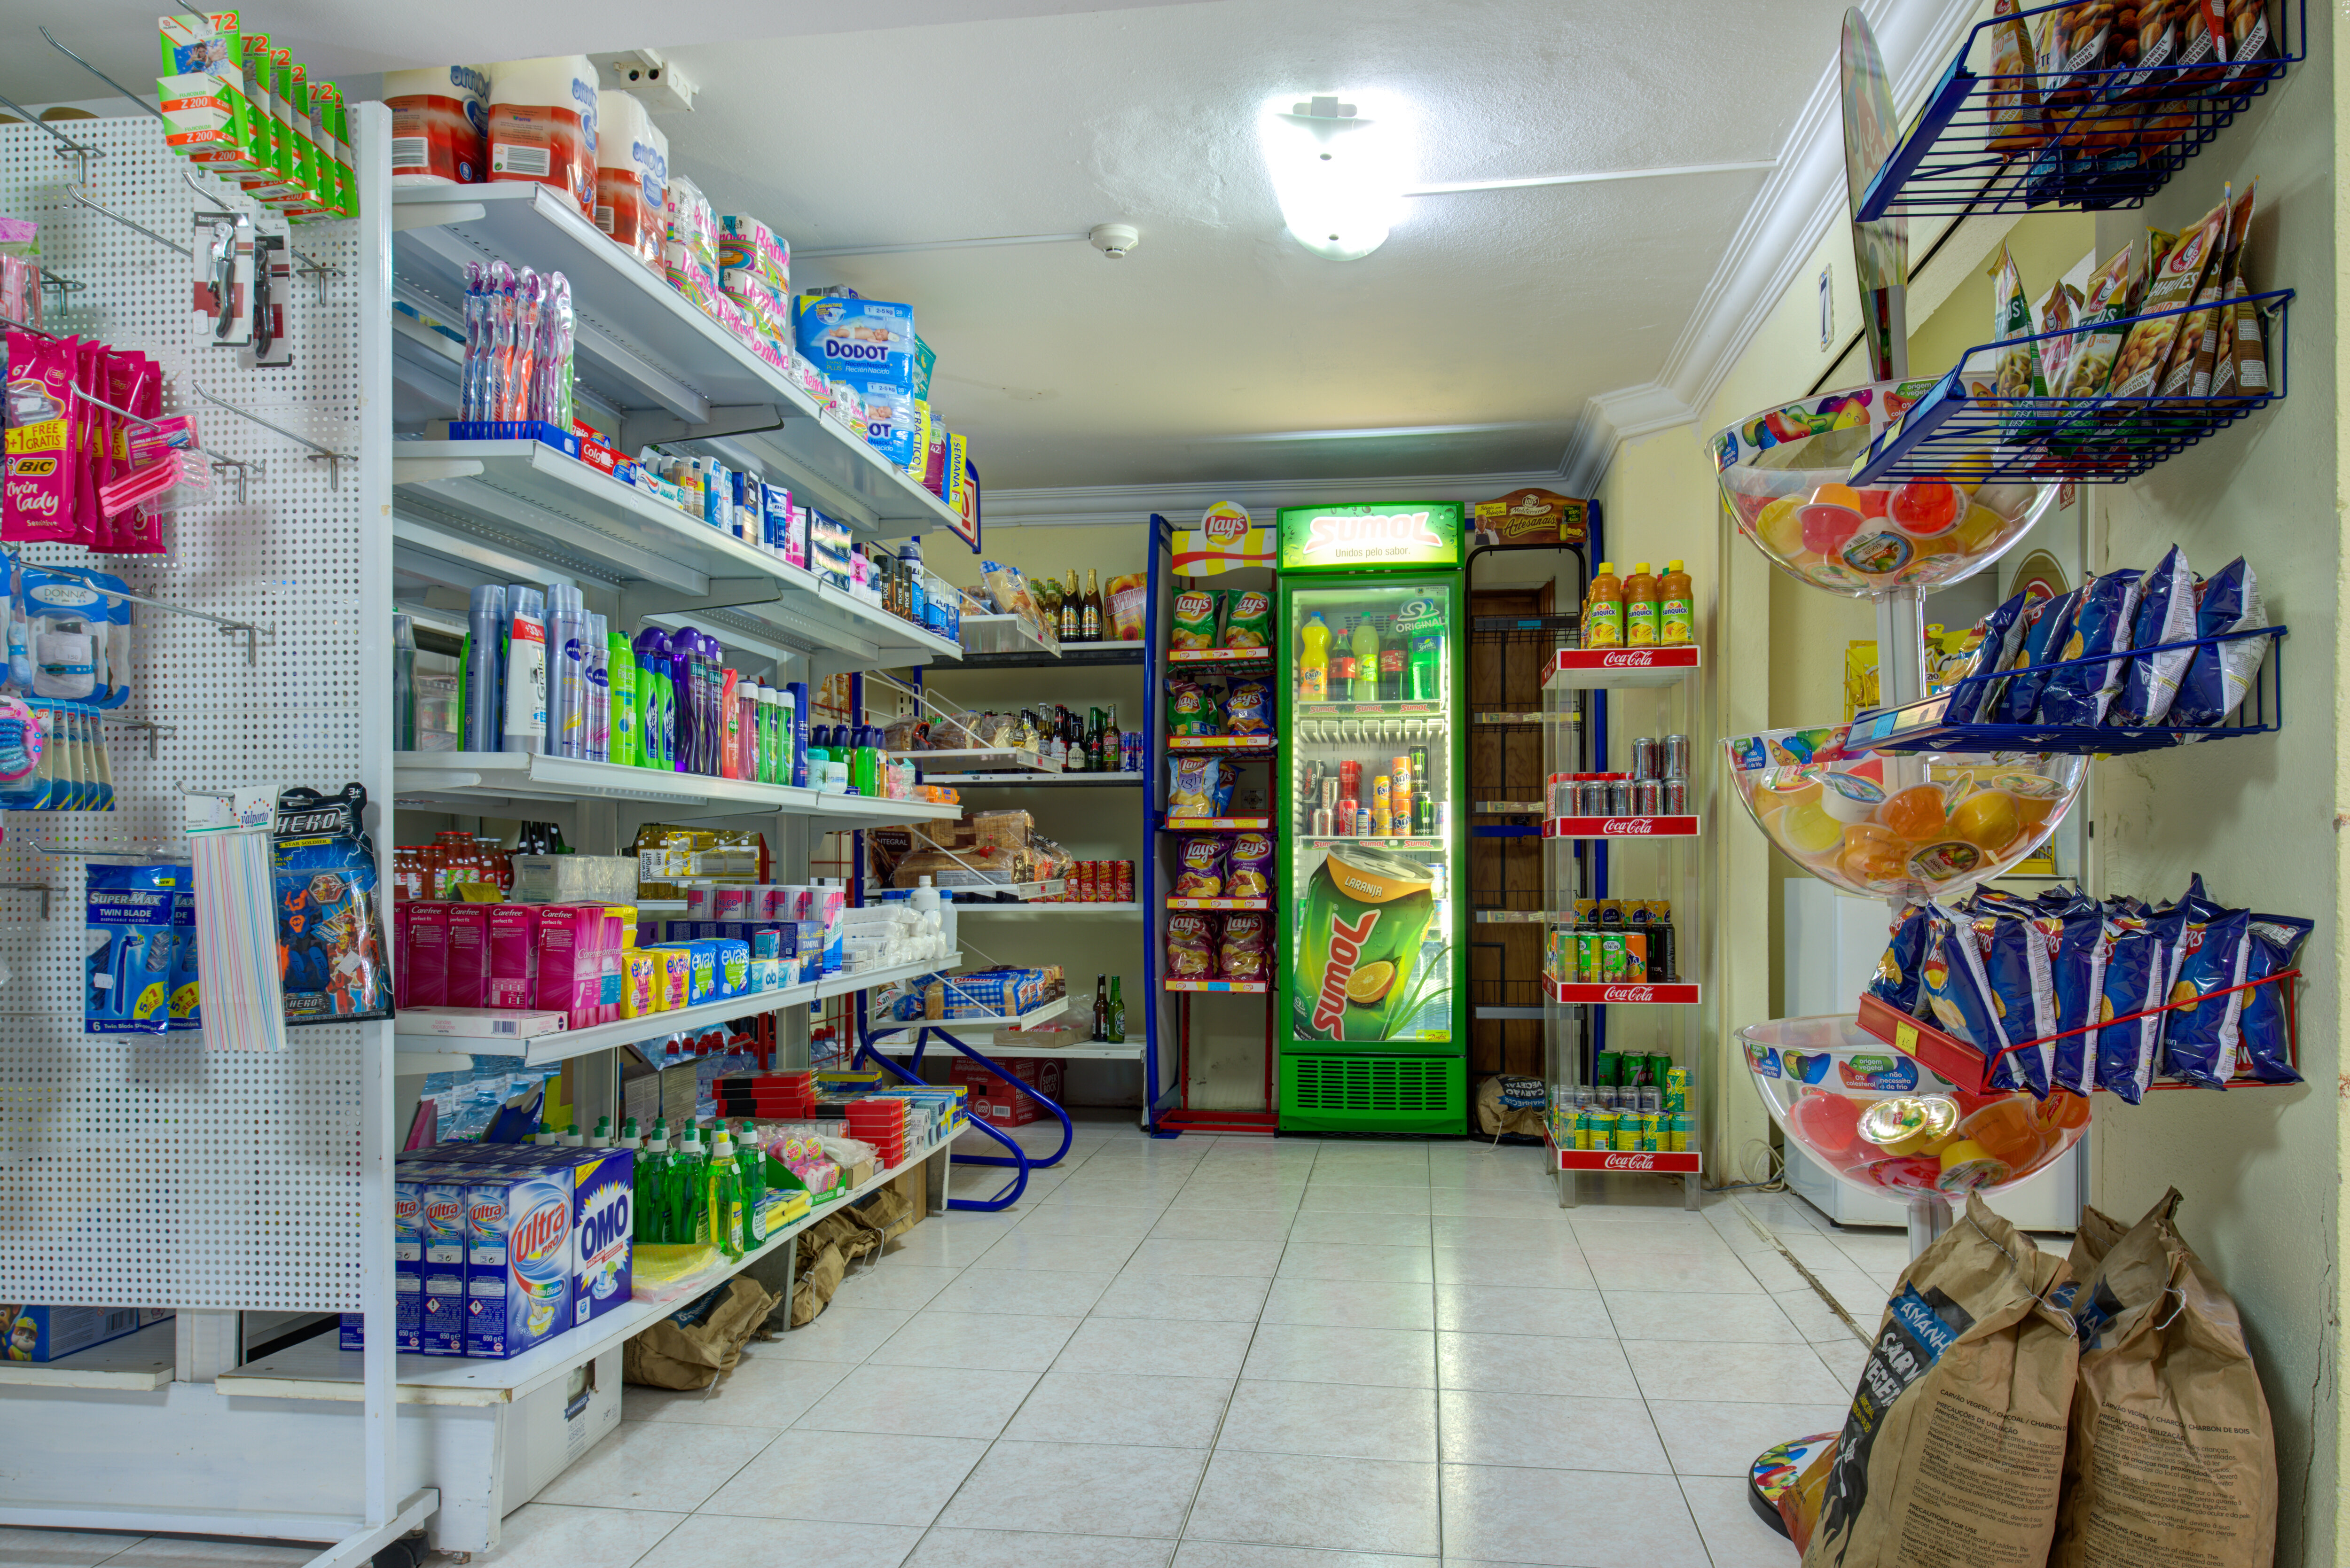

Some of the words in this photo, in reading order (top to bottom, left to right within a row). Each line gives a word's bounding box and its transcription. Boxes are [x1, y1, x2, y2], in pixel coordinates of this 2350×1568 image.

[210, 13, 237, 31] 72
[241, 35, 268, 53] 72
[308, 84, 333, 100] 72
[181, 99, 188, 109] Z
[190, 97, 208, 108] 200
[186, 133, 194, 143] Z
[196, 131, 213, 141] 200
[218, 151, 235, 160] 200
[826, 339, 889, 361] DODOT
[1907, 382, 1932, 390] origem
[32, 423, 59, 437] FREE
[26, 435, 61, 450] GRATIS
[953, 442, 962, 488] SEMANA
[7, 481, 39, 497] twin
[659, 485, 676, 501] Junior
[16, 491, 59, 516] lady
[1524, 496, 1538, 508] Lay's
[1207, 516, 1246, 540] Lay's
[1303, 512, 1443, 554] SUMOL
[1504, 515, 1556, 536] Artesanais
[1335, 548, 1363, 558] Unidos
[1365, 547, 1383, 558] pelo
[1385, 546, 1410, 555] sabor.
[44, 588, 86, 599] DONNA
[1106, 587, 1146, 616] DESPERADOS
[1176, 596, 1212, 616] Lay's
[1120, 617, 1136, 626] TEQUILA
[1395, 616, 1445, 633] ORIGINAL
[1418, 640, 1435, 653] Sprite
[1604, 651, 1654, 667] Coca-Cola
[1305, 671, 1322, 680] Fanta
[1176, 696, 1198, 711] Lay's
[1309, 705, 1339, 714] SUMOL
[1354, 705, 1385, 713] SUMOL
[1400, 704, 1430, 713] SUMOL
[1181, 759, 1206, 771] Lay's
[1393, 773, 1410, 783] Fanta
[241, 810, 269, 827] valporto
[1603, 819, 1653, 834] Coca-Cola
[1186, 843, 1218, 863] Lay's
[1233, 839, 1267, 857] Lay's
[1344, 876, 1383, 897] LARANJA
[124, 909, 152, 917] BLADE
[411, 906, 442, 916] Carefree
[450, 907, 480, 916] Carefree
[492, 908, 523, 917] Carefree
[541, 909, 572, 919] Carefree
[1169, 918, 1201, 935] Lay's
[1226, 916, 1259, 934] Lay's
[802, 940, 819, 949] TAMPAX
[578, 948, 603, 960] Carefree
[692, 951, 716, 971] evax
[632, 959, 655, 978] evax
[1314, 909, 1381, 1041] SUMOL
[1604, 987, 1654, 1001] Coca-Cola
[1042, 1073, 1057, 1085] SUPER
[1043, 1084, 1057, 1094] BOCK
[1505, 1088, 1544, 1096] CARVÃO
[787, 1145, 799, 1155] Scotch
[790, 1151, 799, 1160] Brite
[1605, 1154, 1655, 1169] Coca-Cola
[428, 1203, 458, 1220] Ultra
[472, 1205, 502, 1221] Ultra
[515, 1202, 566, 1264] Ultra
[580, 1194, 628, 1261] OMO
[541, 1234, 559, 1257] PRO
[1936, 1400, 1975, 1422] PRECAUÇÕES
[1940, 1389, 1965, 1403] CARVÃO
[1966, 1399, 1991, 1414] VEGETAL
[2030, 1420, 2062, 1431] CHARBON
[2101, 1401, 2126, 1413] CARVÃO
[2188, 1424, 2222, 1433] CHARBON
[1961, 1417, 1983, 1431] Manter
[2098, 1412, 2140, 1431] PRECAUÇÕES
[2148, 1428, 2186, 1442] UTILIZAÇÃO
[1908, 1502, 1950, 1525] PRECAUTIONS
[1951, 1521, 1964, 1530] FOR
[1965, 1525, 1978, 1535] USE
[2089, 1511, 2128, 1536] PRECAUTIONS
[2129, 1529, 2143, 1540] FOR
[2144, 1534, 2158, 1544] USE
